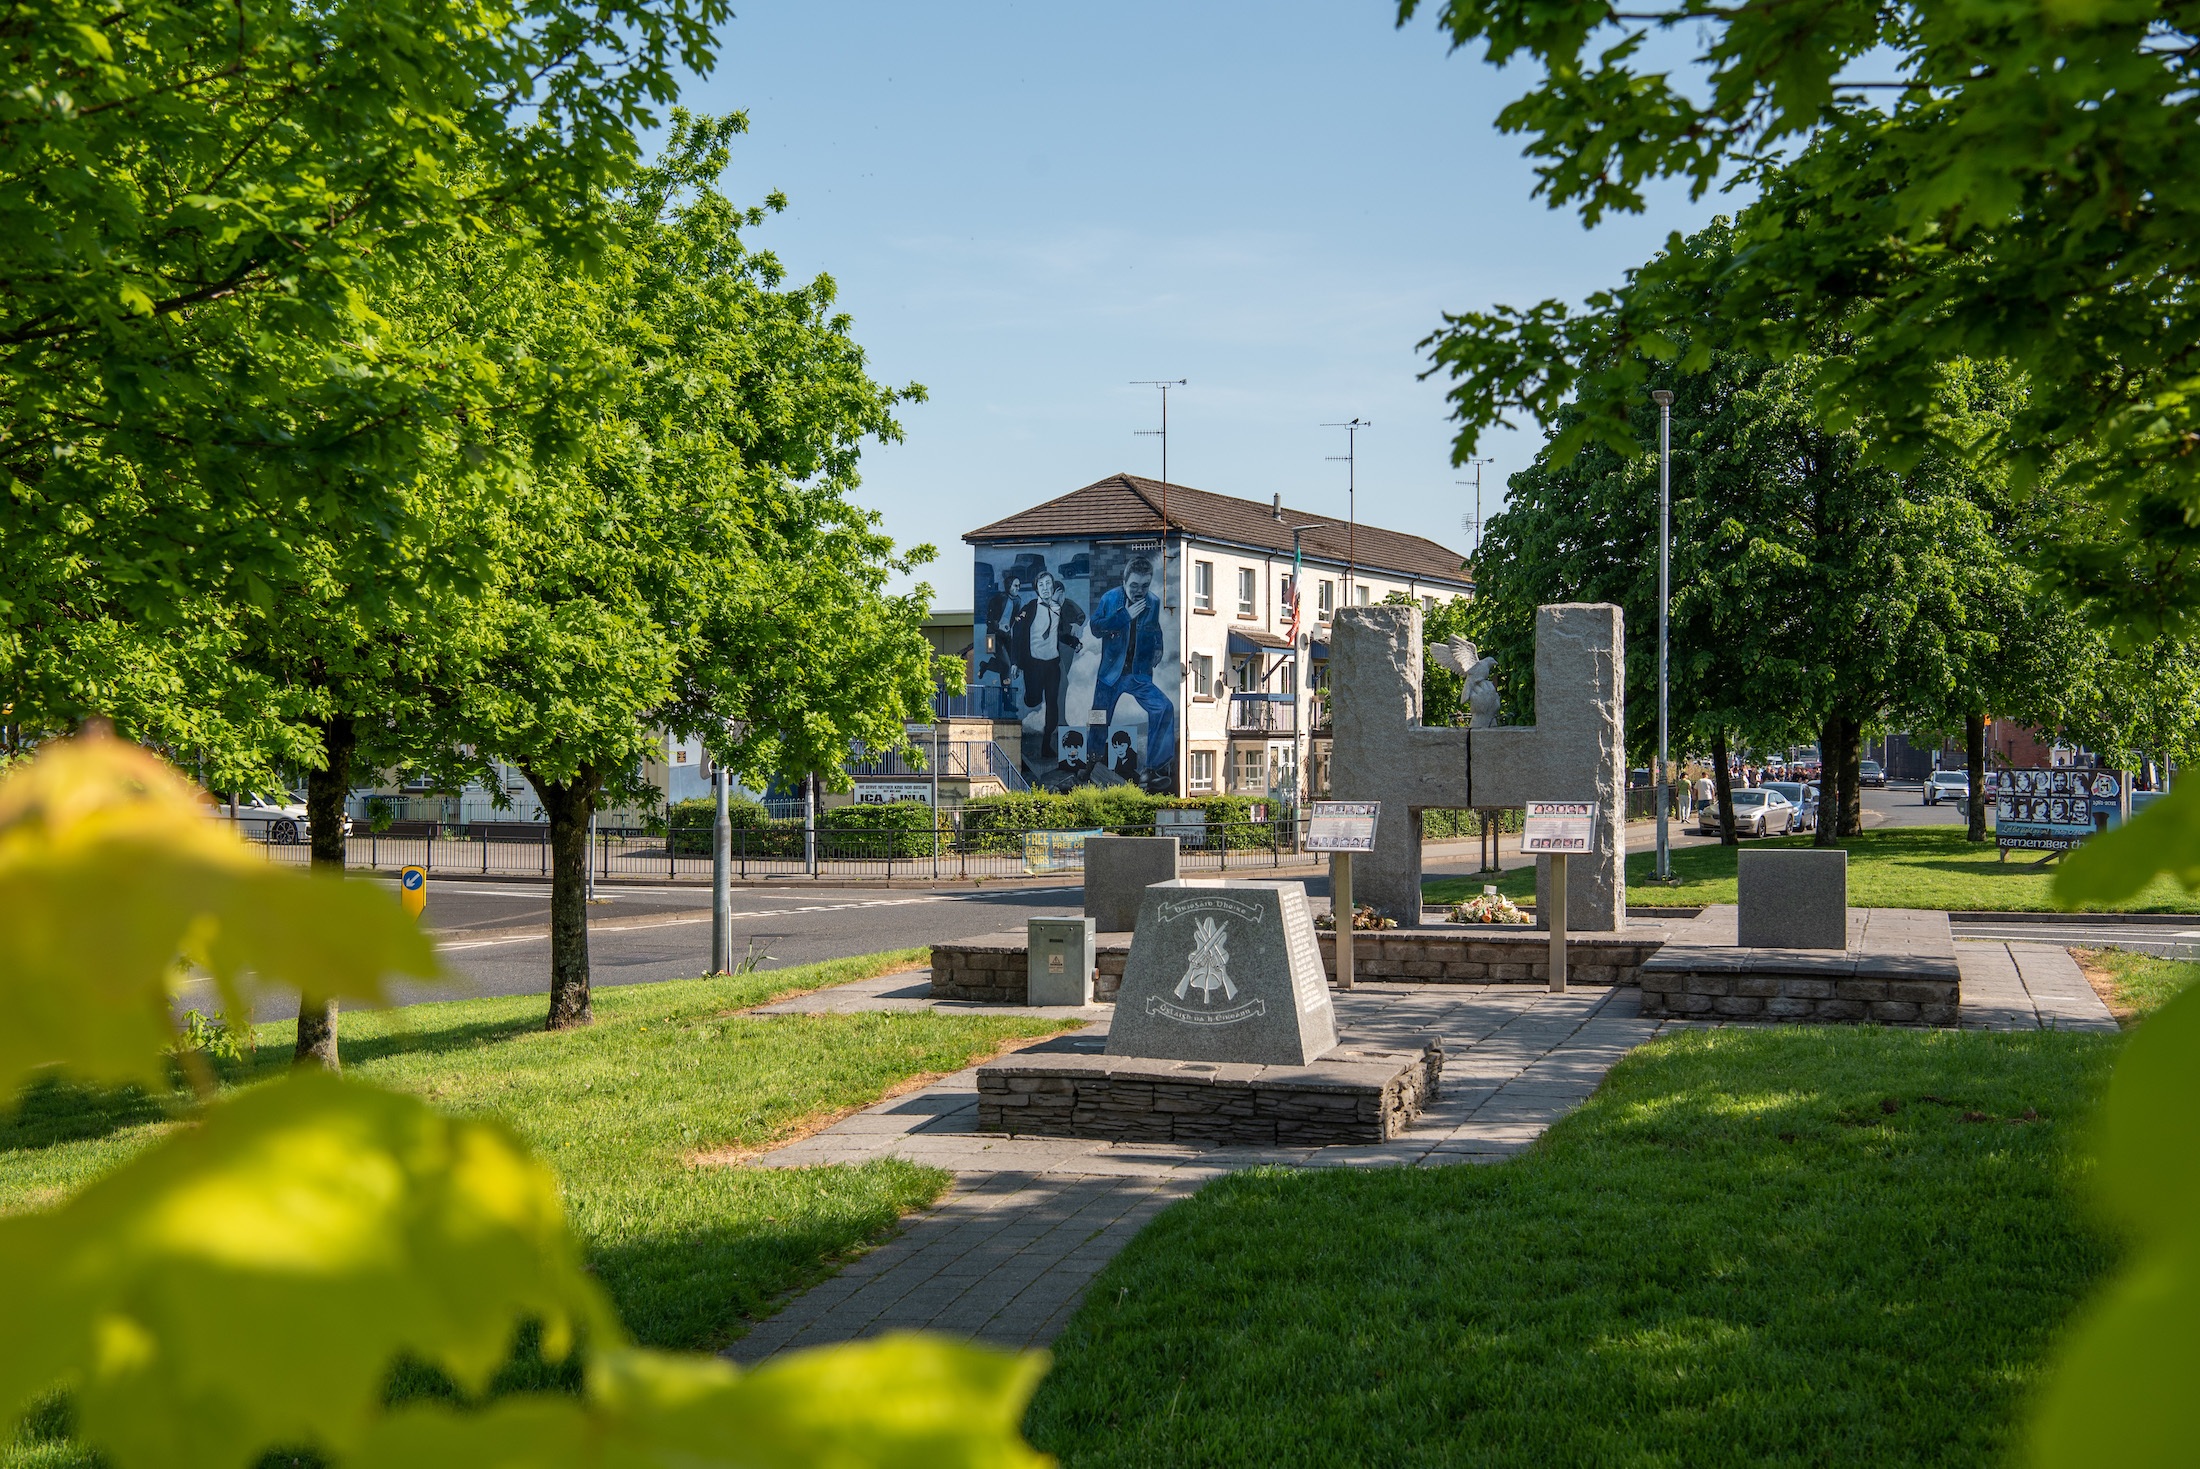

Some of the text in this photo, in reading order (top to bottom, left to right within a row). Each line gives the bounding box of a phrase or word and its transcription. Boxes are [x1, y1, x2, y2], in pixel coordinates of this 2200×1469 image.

[1025, 832, 1049, 845] FREE
[1026, 845, 1049, 855] DERRY
[1026, 855, 1050, 865] TOURS
